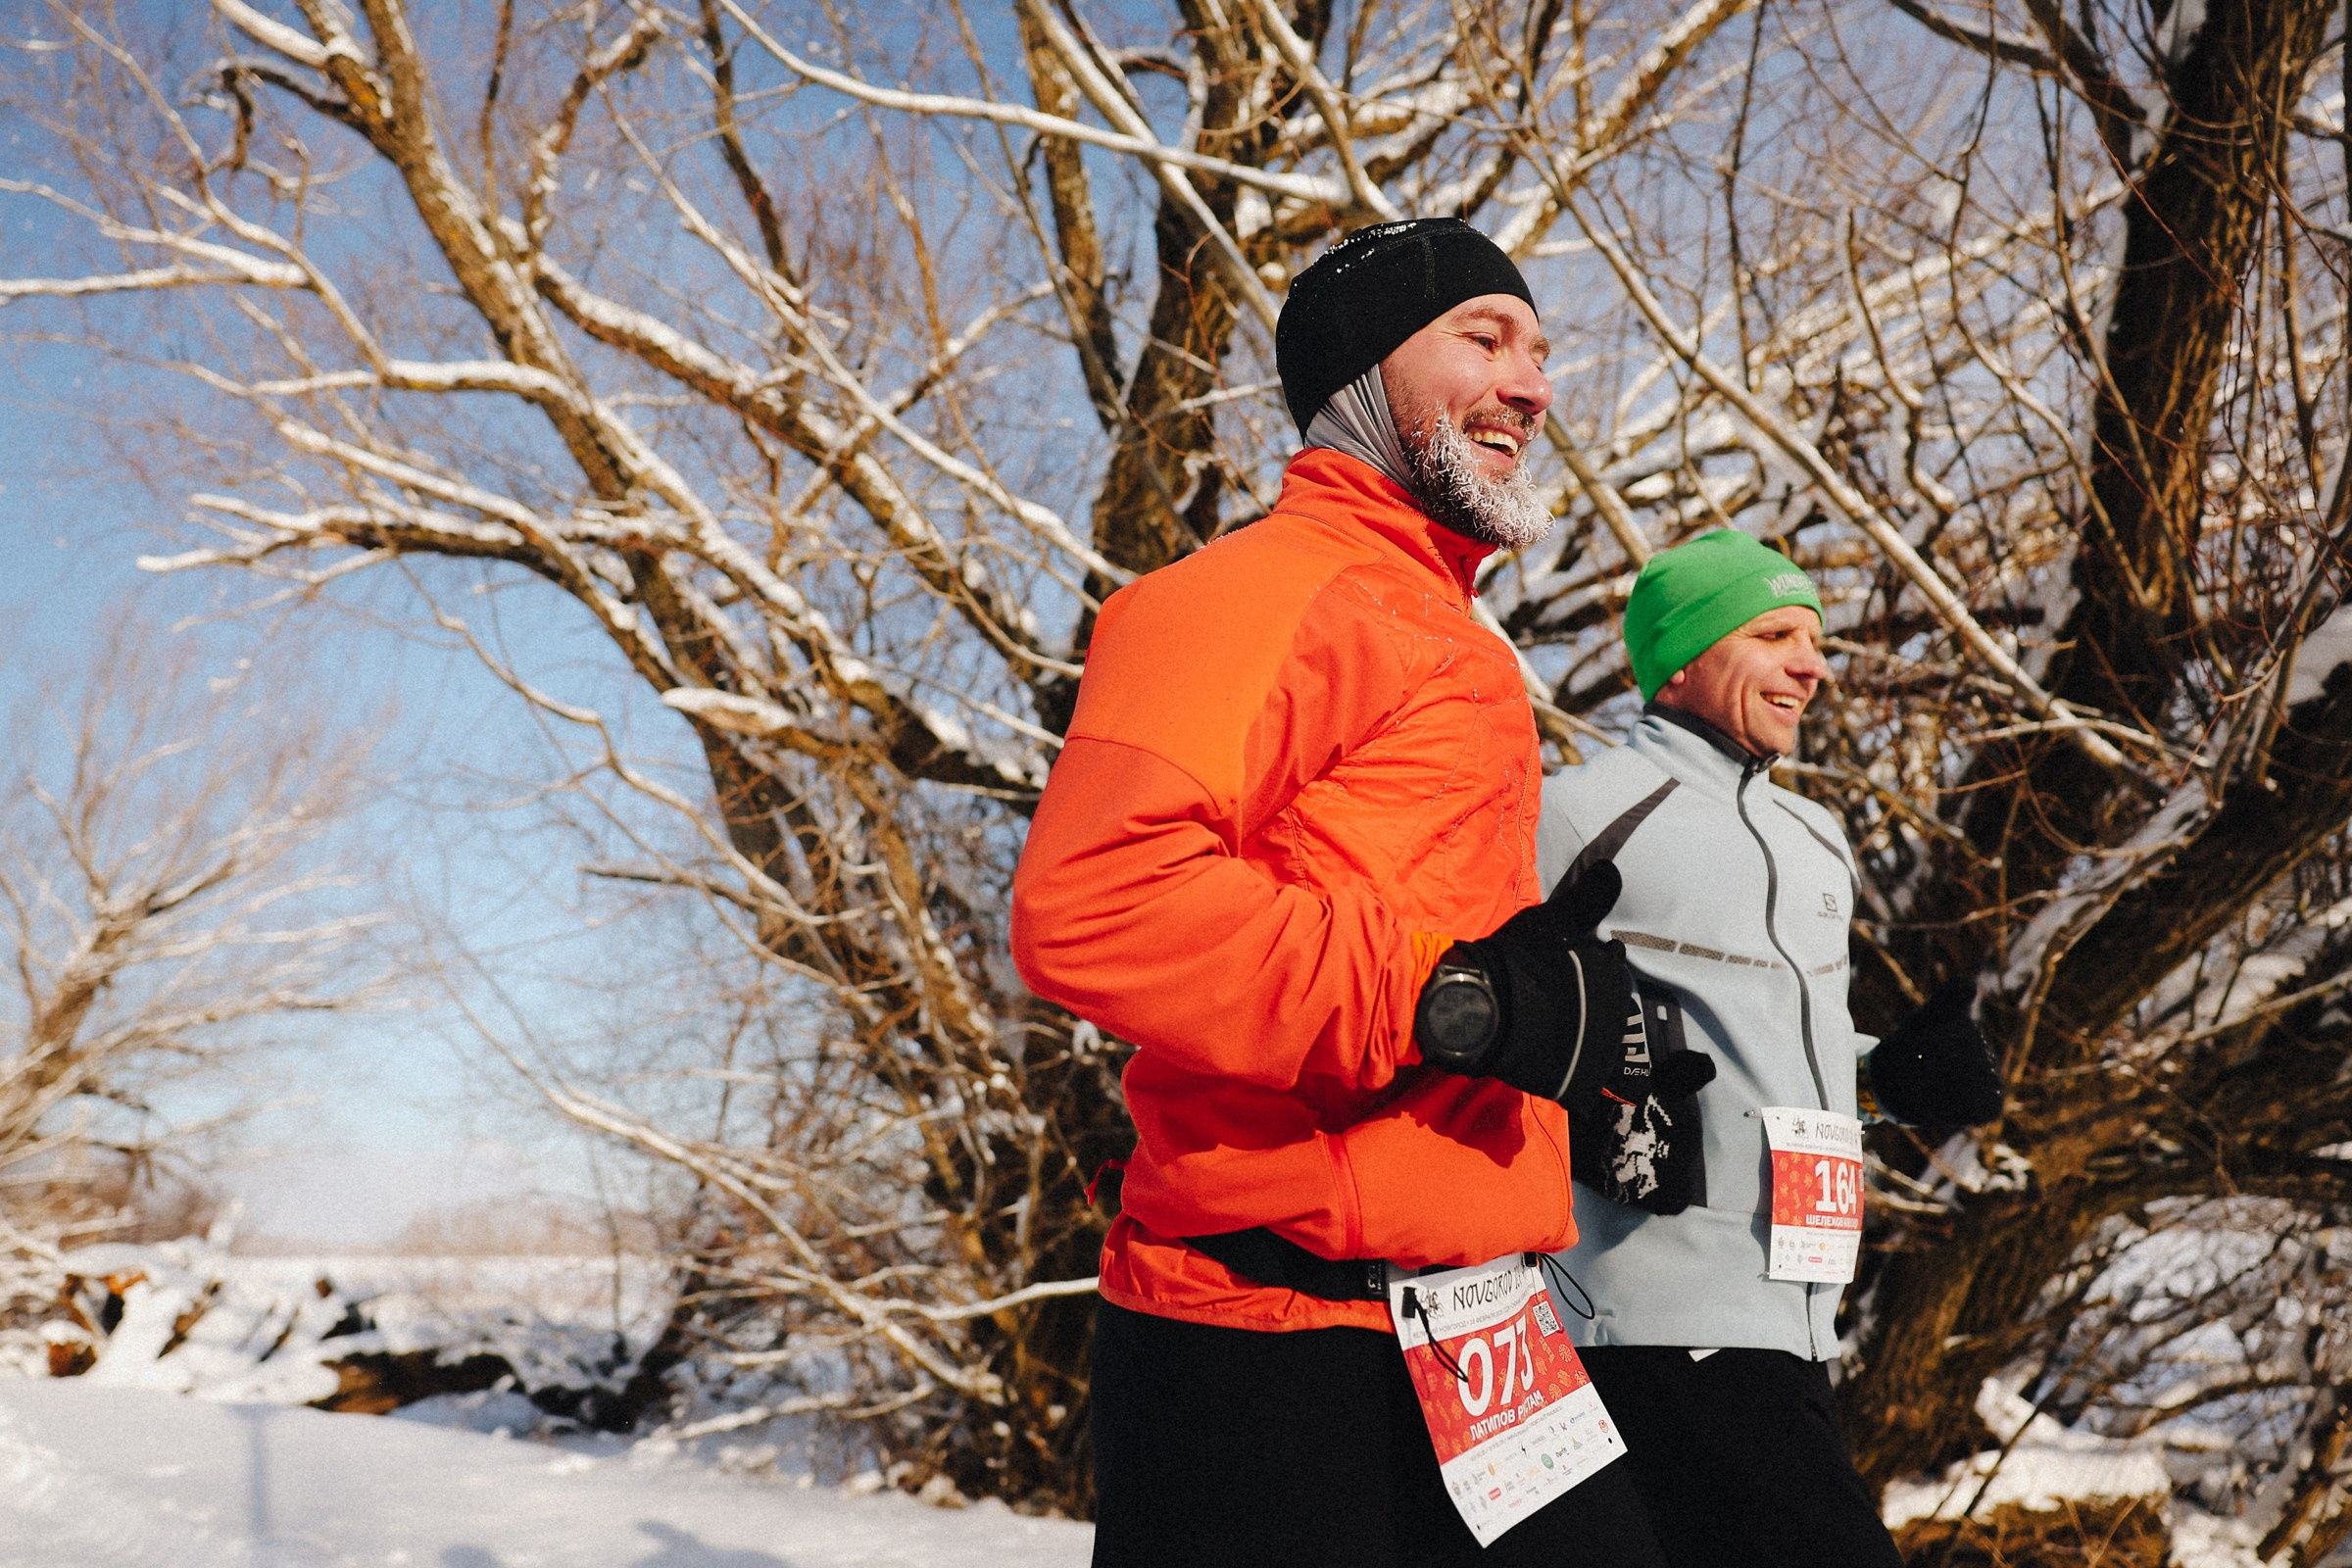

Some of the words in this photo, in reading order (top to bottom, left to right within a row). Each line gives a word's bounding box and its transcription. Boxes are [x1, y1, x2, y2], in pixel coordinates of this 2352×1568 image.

[1815, 1159, 1856, 1215] 164
[1453, 1270, 1512, 1311] NOVGOROD
[1458, 1313, 1534, 1417] 073
[1470, 1408, 1516, 1441] ЛАТИПОВ
